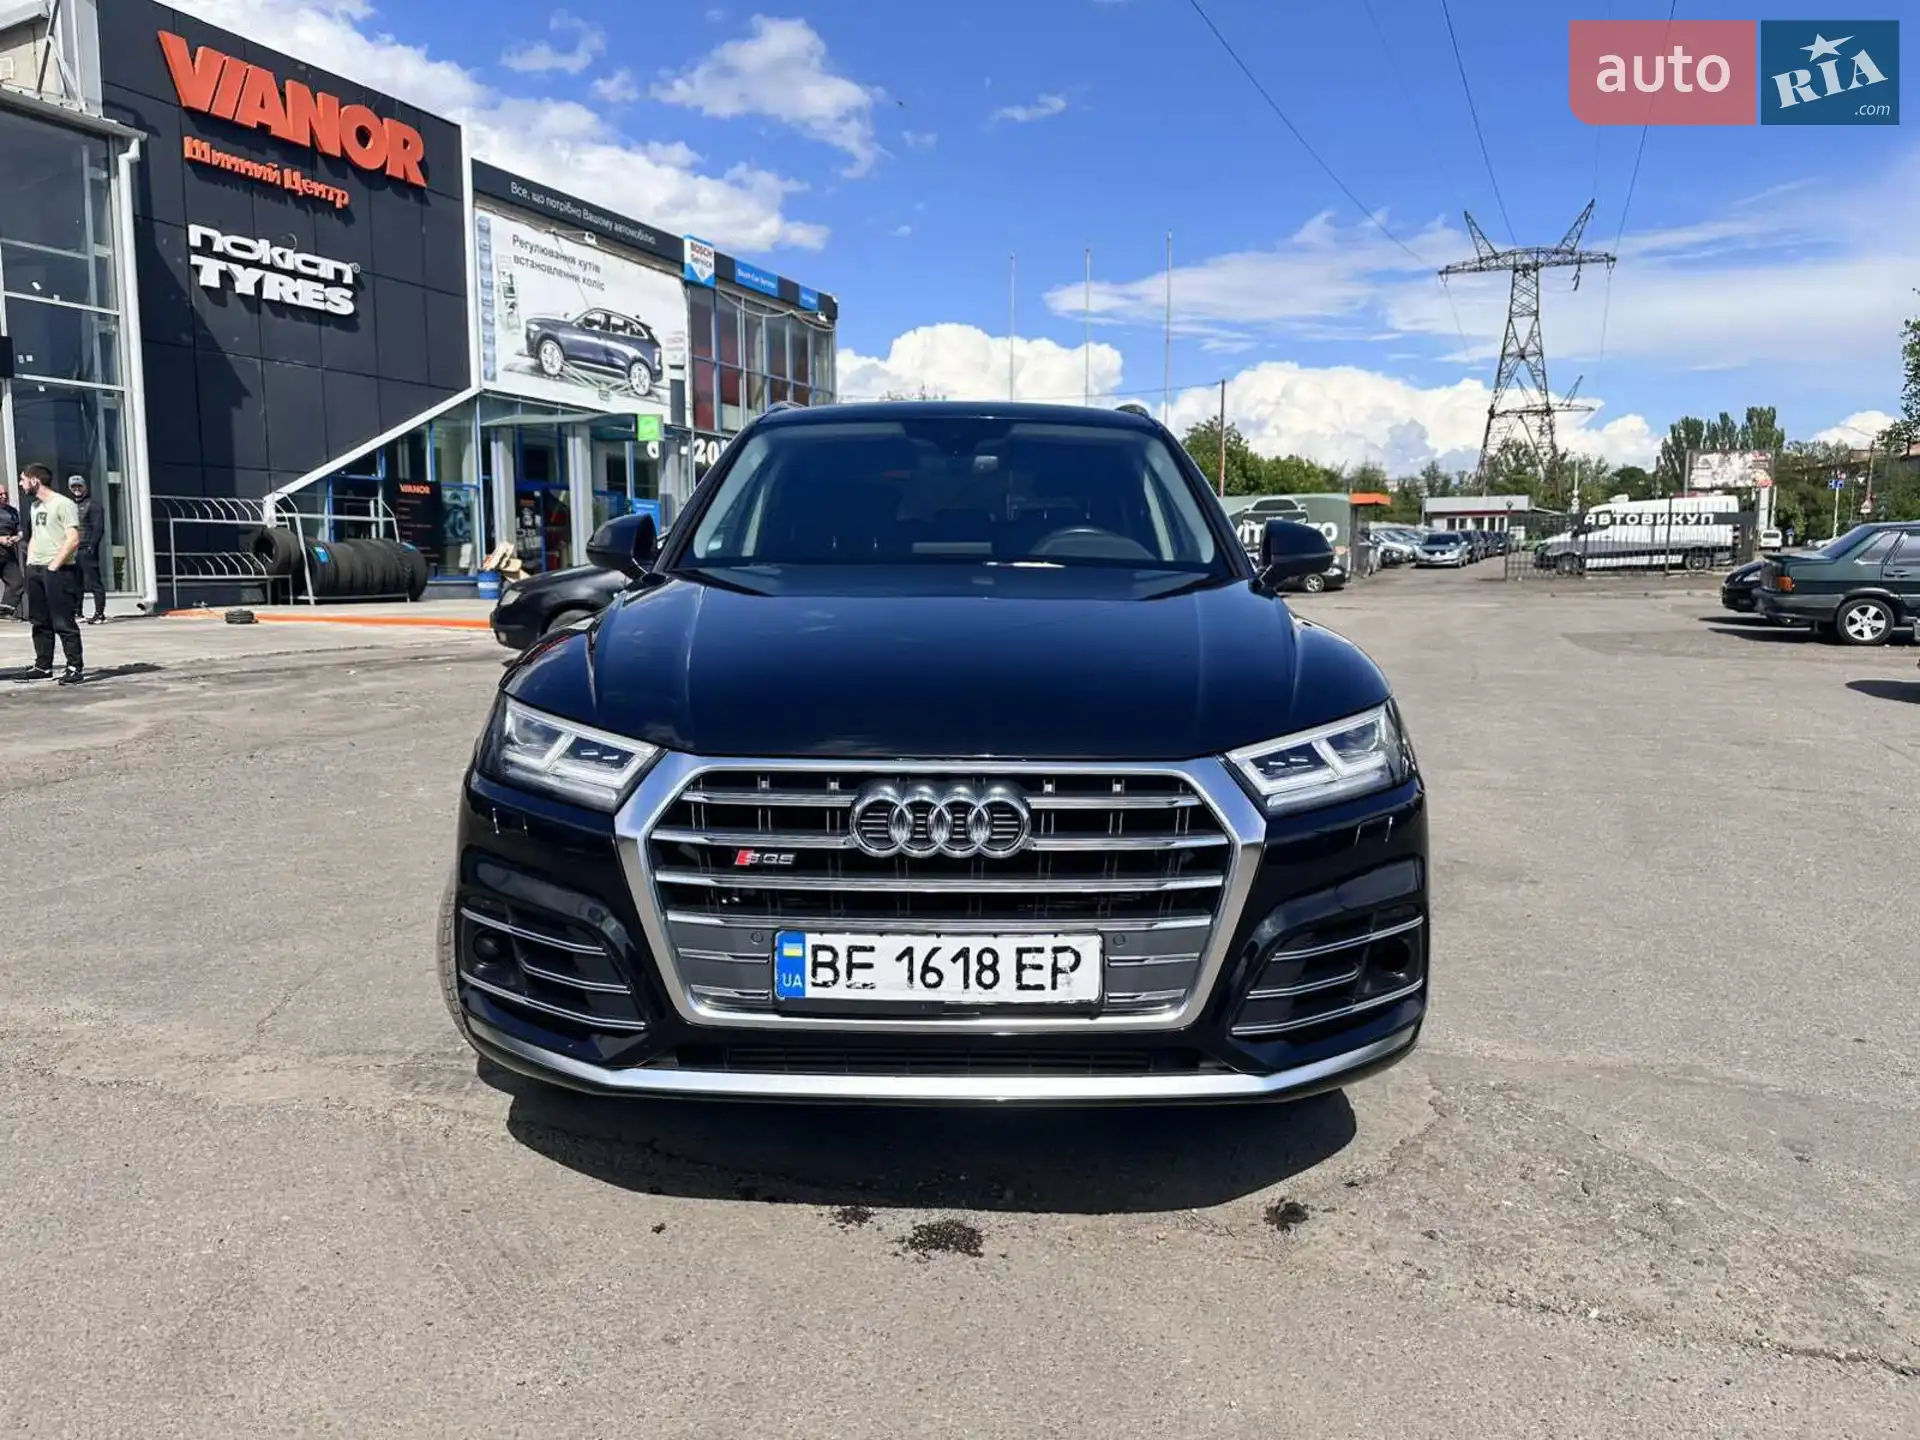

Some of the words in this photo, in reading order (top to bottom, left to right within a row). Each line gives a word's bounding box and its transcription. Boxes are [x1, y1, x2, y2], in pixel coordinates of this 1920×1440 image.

[157, 30, 427, 188] VIANOR
[283, 168, 349, 208] Центр
[190, 254, 355, 315] TYRES
[1583, 512, 1714, 526] АВТОВИКУП
[782, 974, 801, 989] UA
[895, 945, 1000, 990] 1618
[1015, 945, 1082, 991] EP
